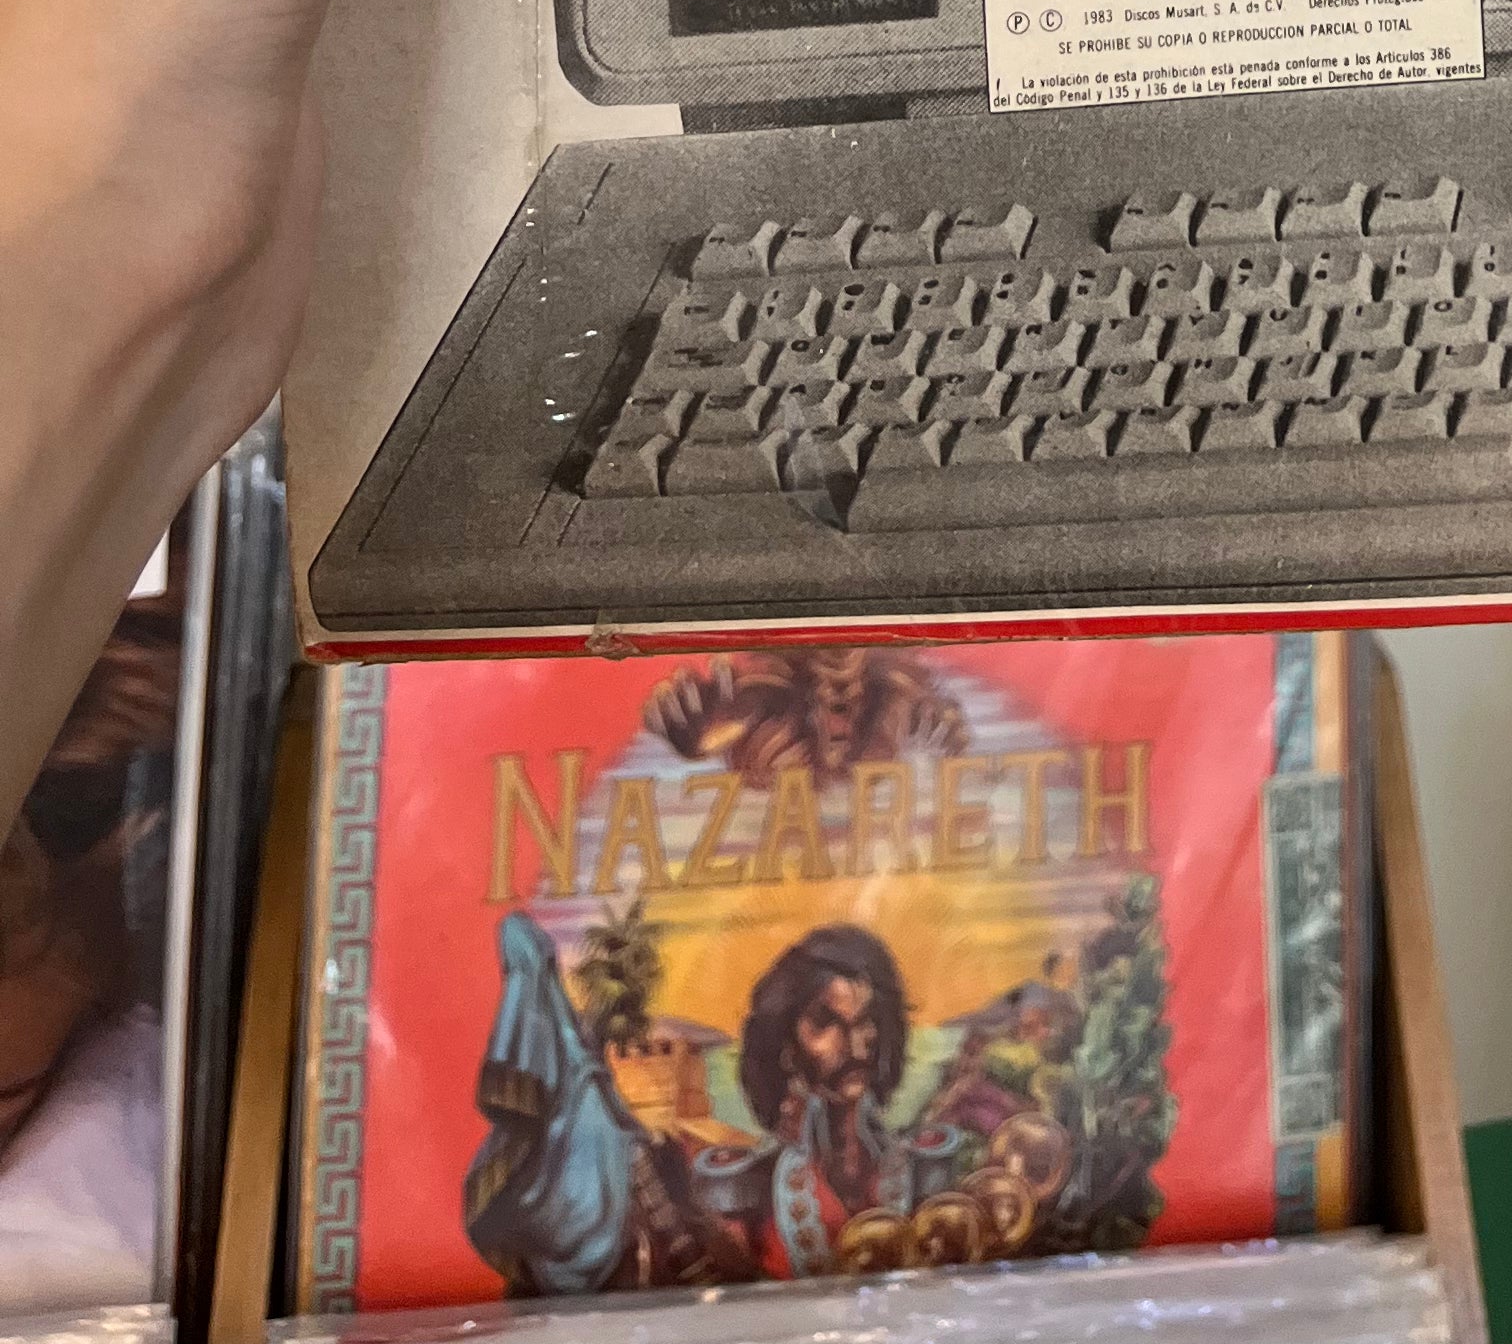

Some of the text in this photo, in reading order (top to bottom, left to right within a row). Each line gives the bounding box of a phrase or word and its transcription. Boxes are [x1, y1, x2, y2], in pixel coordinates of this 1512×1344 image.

[1058, 18, 1412, 55] SE PROHIBE SU COPIA O REPRODUCCION PARCIAL O TOTAL
[1084, 9, 1113, 25] 1983
[1125, 9, 1160, 22] Discos
[993, 95, 1010, 107] del
[1016, 93, 1054, 106] Código
[1060, 88, 1091, 102] Penal
[1110, 85, 1129, 99] 135
[1148, 83, 1167, 96] 136
[1173, 83, 1186, 94] de
[1193, 82, 1202, 92] la
[1208, 80, 1225, 93] Ley
[1231, 75, 1271, 89] Federal
[1278, 74, 1307, 87] sobre
[1312, 72, 1322, 84] el
[1328, 69, 1373, 83] Derecho
[1379, 68, 1392, 80] de
[1436, 63, 1481, 77] vigentes
[1022, 77, 1035, 89] La
[1040, 74, 1089, 88] violación
[1095, 72, 1108, 84] de
[1114, 70, 1137, 83] esta
[1143, 65, 1205, 82] prohibición
[1240, 60, 1280, 75] penada
[1286, 56, 1338, 70] conforme
[1356, 53, 1371, 65] los
[1430, 47, 1451, 61] 386
[485, 739, 1152, 904] NAZARETH
